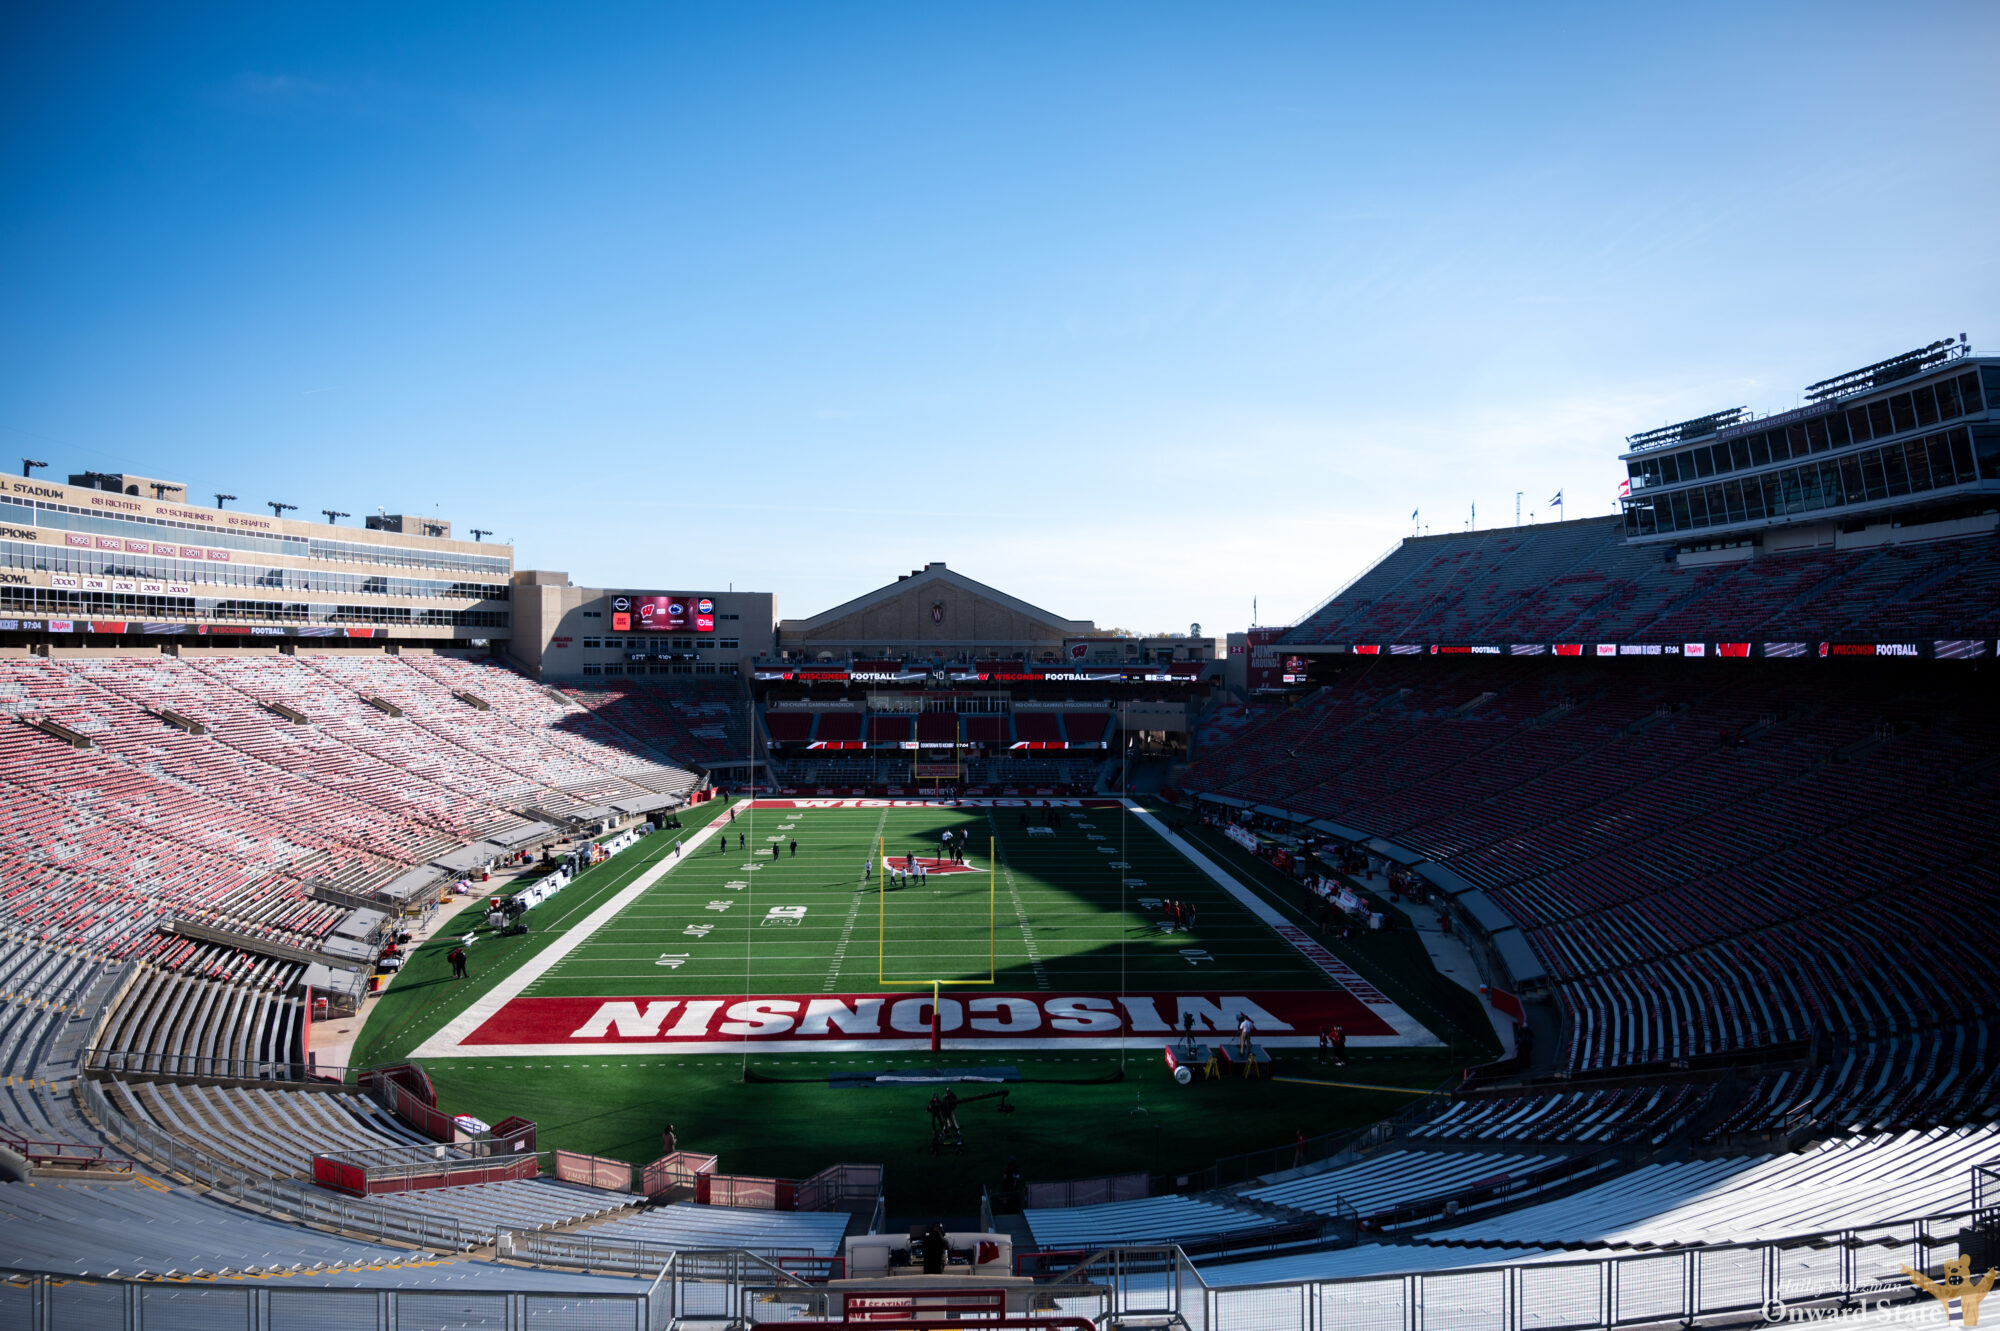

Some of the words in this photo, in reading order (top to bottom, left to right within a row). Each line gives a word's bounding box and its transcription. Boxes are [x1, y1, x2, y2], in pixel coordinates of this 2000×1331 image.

[1743, 411, 1801, 433] COMMUNICATIONS
[1803, 403, 1831, 416] CENTER
[13, 483, 63, 499] STADIUM
[105, 498, 141, 511] RICHTER
[169, 509, 214, 522] SCHREINER
[240, 519, 270, 529] SHAFER
[157, 546, 175, 554] 2010
[53, 578, 76, 586] 2000
[169, 586, 189, 594] 2020
[23, 621, 41, 629] 97:04
[211, 626, 250, 634] WISCONSIN
[251, 627, 284, 635] FOOTBALL
[1664, 646, 1679, 654] 97:04
[1832, 644, 1875, 655] WISCONSIN
[1876, 644, 1918, 655] FOOTBALL
[932, 671, 945, 680] 40
[792, 800, 1084, 808] WISCONSIN
[682, 924, 715, 935] 20
[654, 952, 691, 966] 10
[569, 995, 1296, 1039] WISCONSIN
